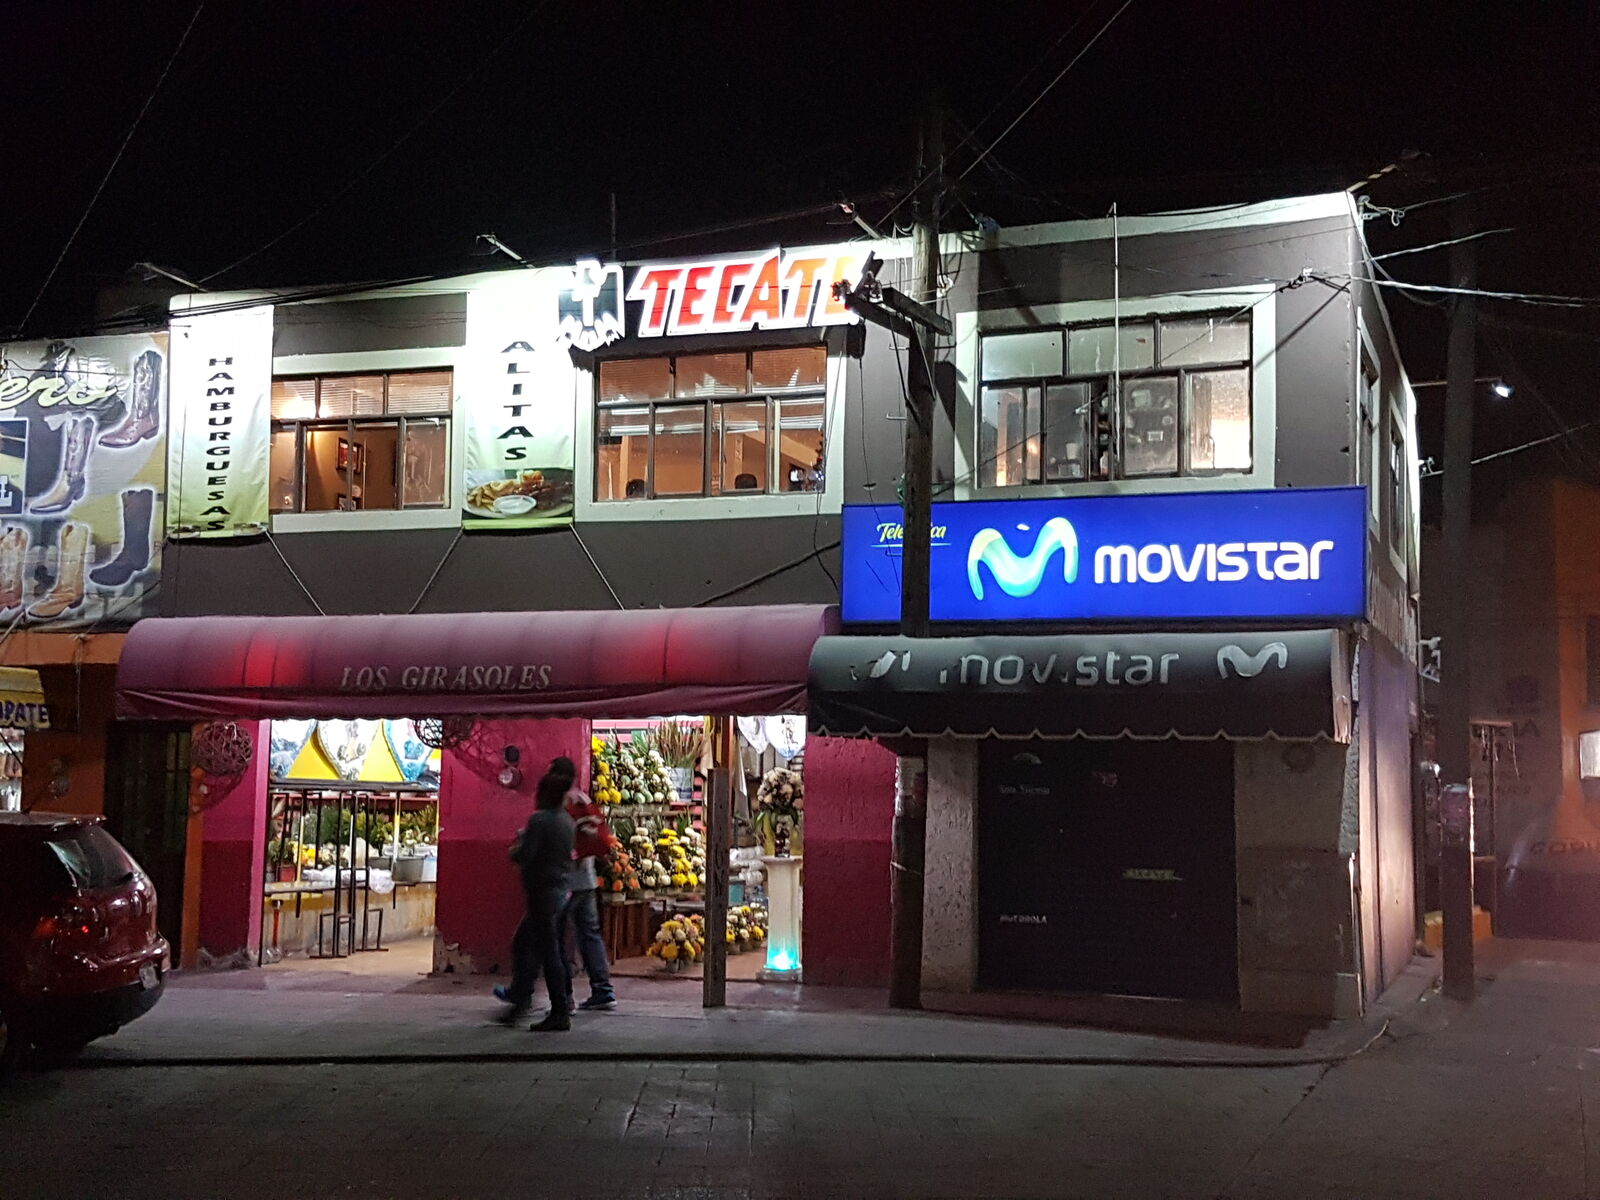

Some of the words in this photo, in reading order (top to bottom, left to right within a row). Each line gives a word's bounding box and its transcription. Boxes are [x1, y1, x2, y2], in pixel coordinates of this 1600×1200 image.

[497, 341, 536, 462] ALITAS
[202, 357, 236, 532] HAMBURGUESAS
[1094, 540, 1335, 584] movistar
[341, 665, 389, 690] LOS
[401, 664, 553, 691] GIRASOLES
[939, 650, 1180, 687] movstar
